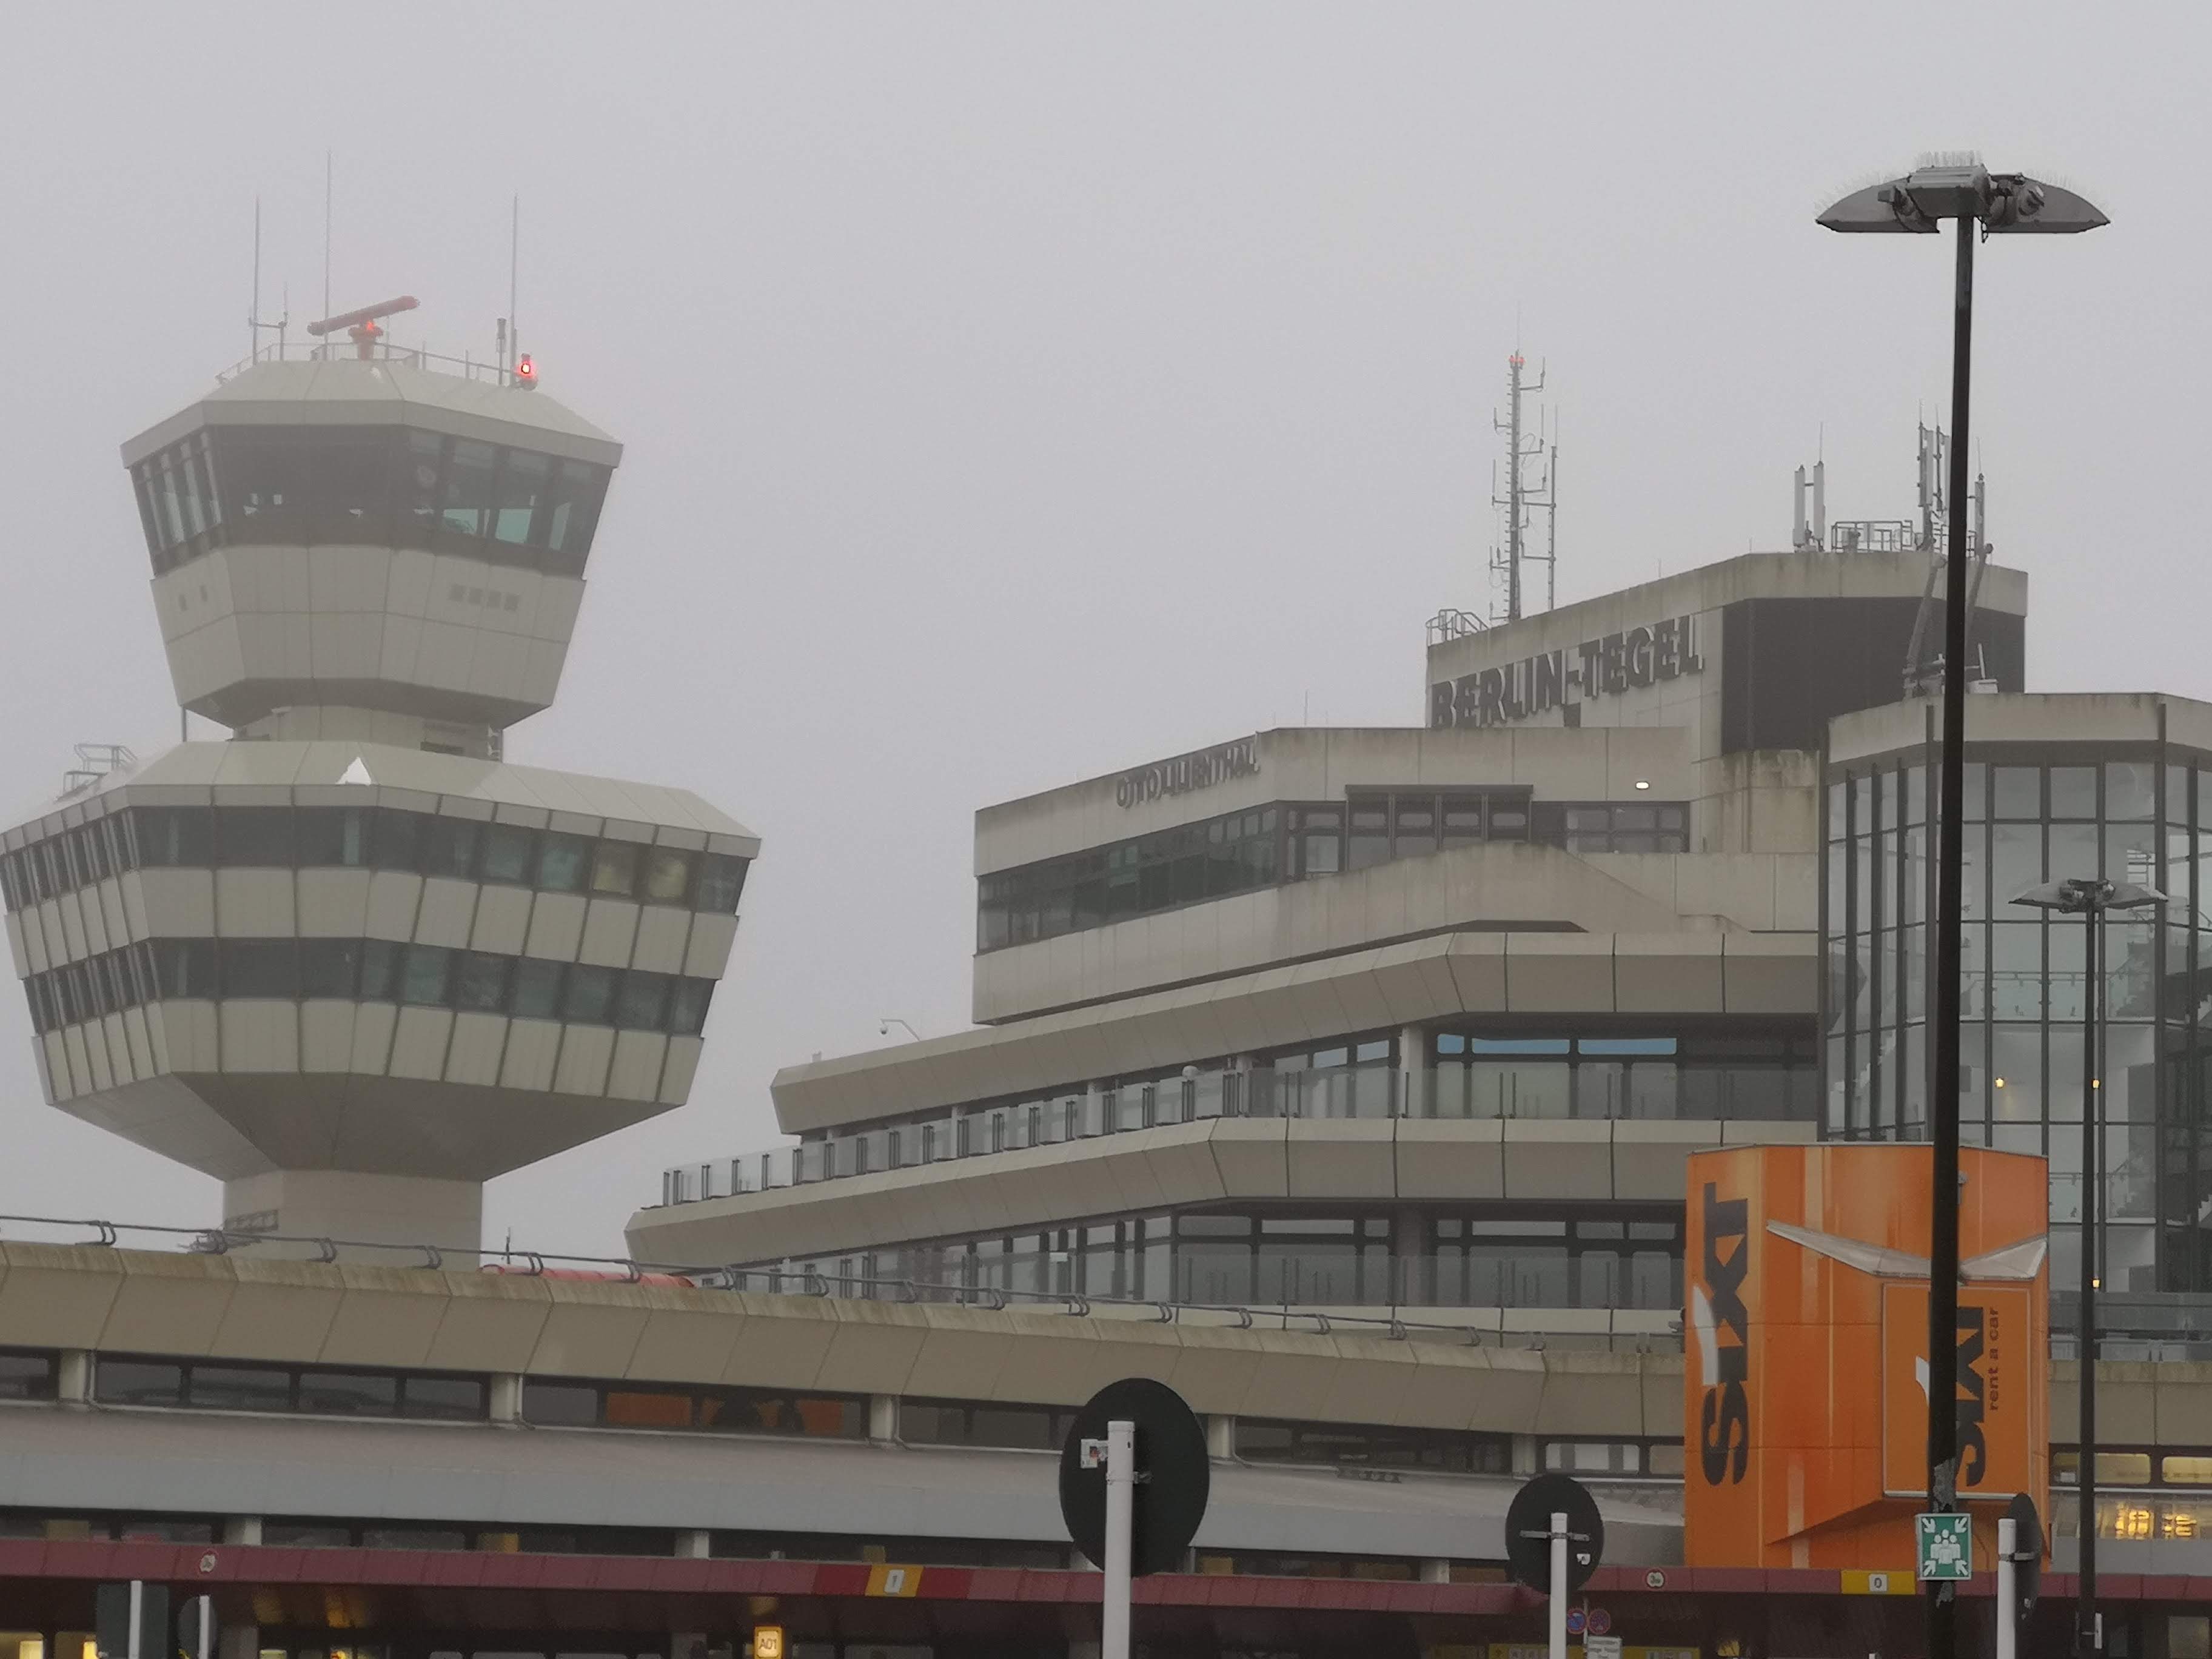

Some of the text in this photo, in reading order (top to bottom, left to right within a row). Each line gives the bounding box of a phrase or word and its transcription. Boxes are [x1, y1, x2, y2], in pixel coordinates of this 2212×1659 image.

[1432, 614, 1703, 727] BERLIN-TEGEL
[1702, 1182, 1749, 1486] SIXT
[1988, 1307, 1999, 1410] rent a car
